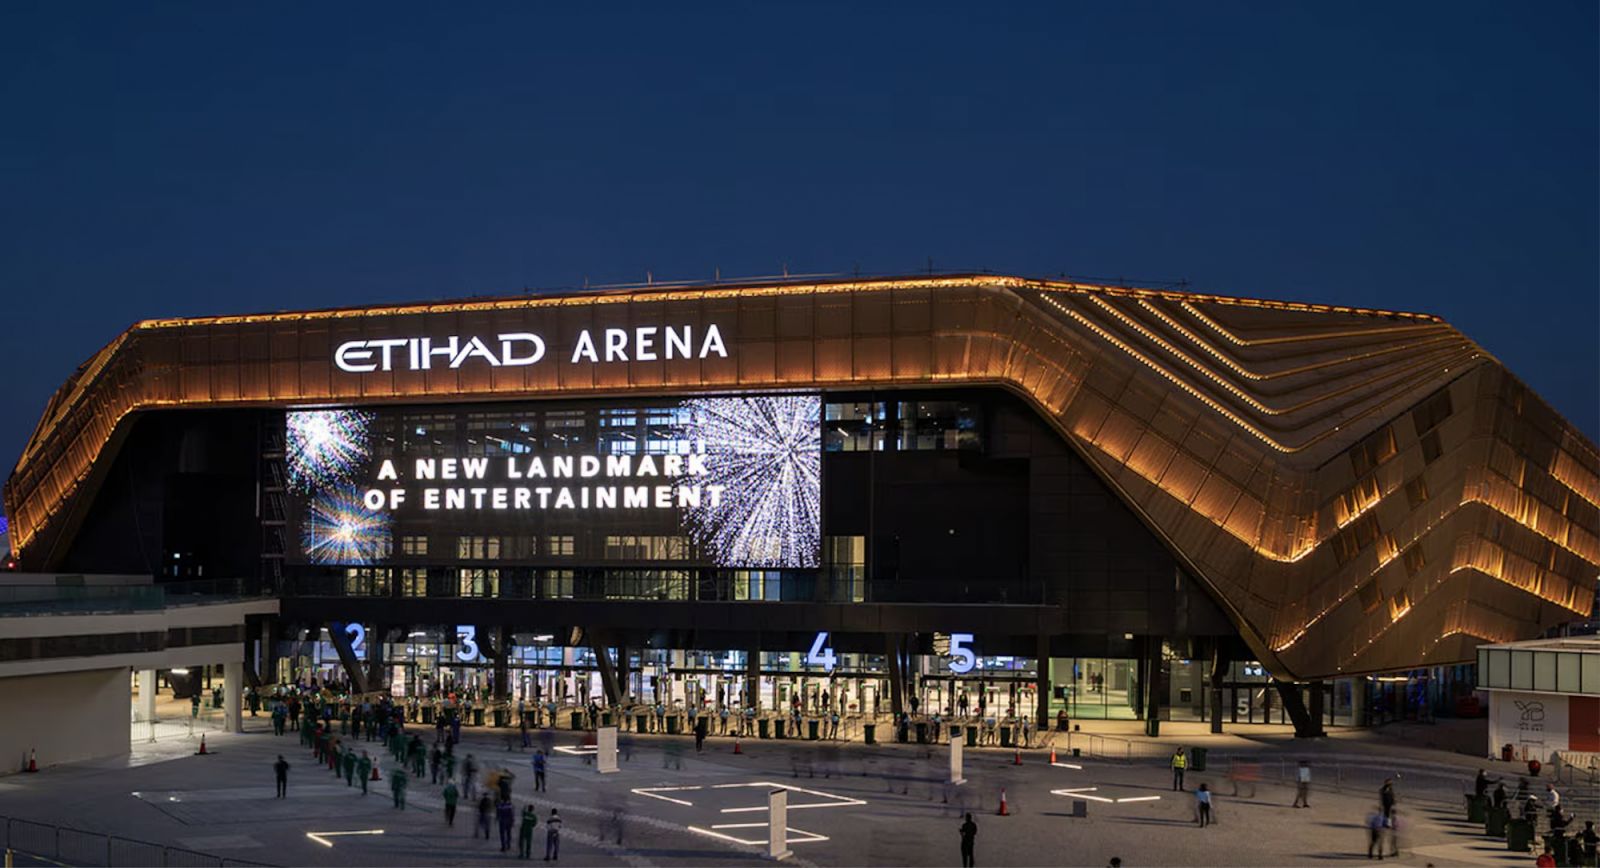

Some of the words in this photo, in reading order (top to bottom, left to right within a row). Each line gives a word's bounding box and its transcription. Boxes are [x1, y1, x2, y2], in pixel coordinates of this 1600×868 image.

[334, 332, 546, 372] ETIHAD
[571, 323, 728, 364] ARENA
[377, 459, 398, 480] A
[415, 457, 489, 480] NEW
[508, 454, 710, 479] LANDMARK
[363, 489, 406, 511] OF
[424, 484, 726, 509] ENTERTAINMENT
[345, 622, 366, 661] 2
[456, 625, 479, 661] 3
[807, 632, 837, 672] 4
[948, 634, 976, 673] 5
[1237, 698, 1249, 715] 5
